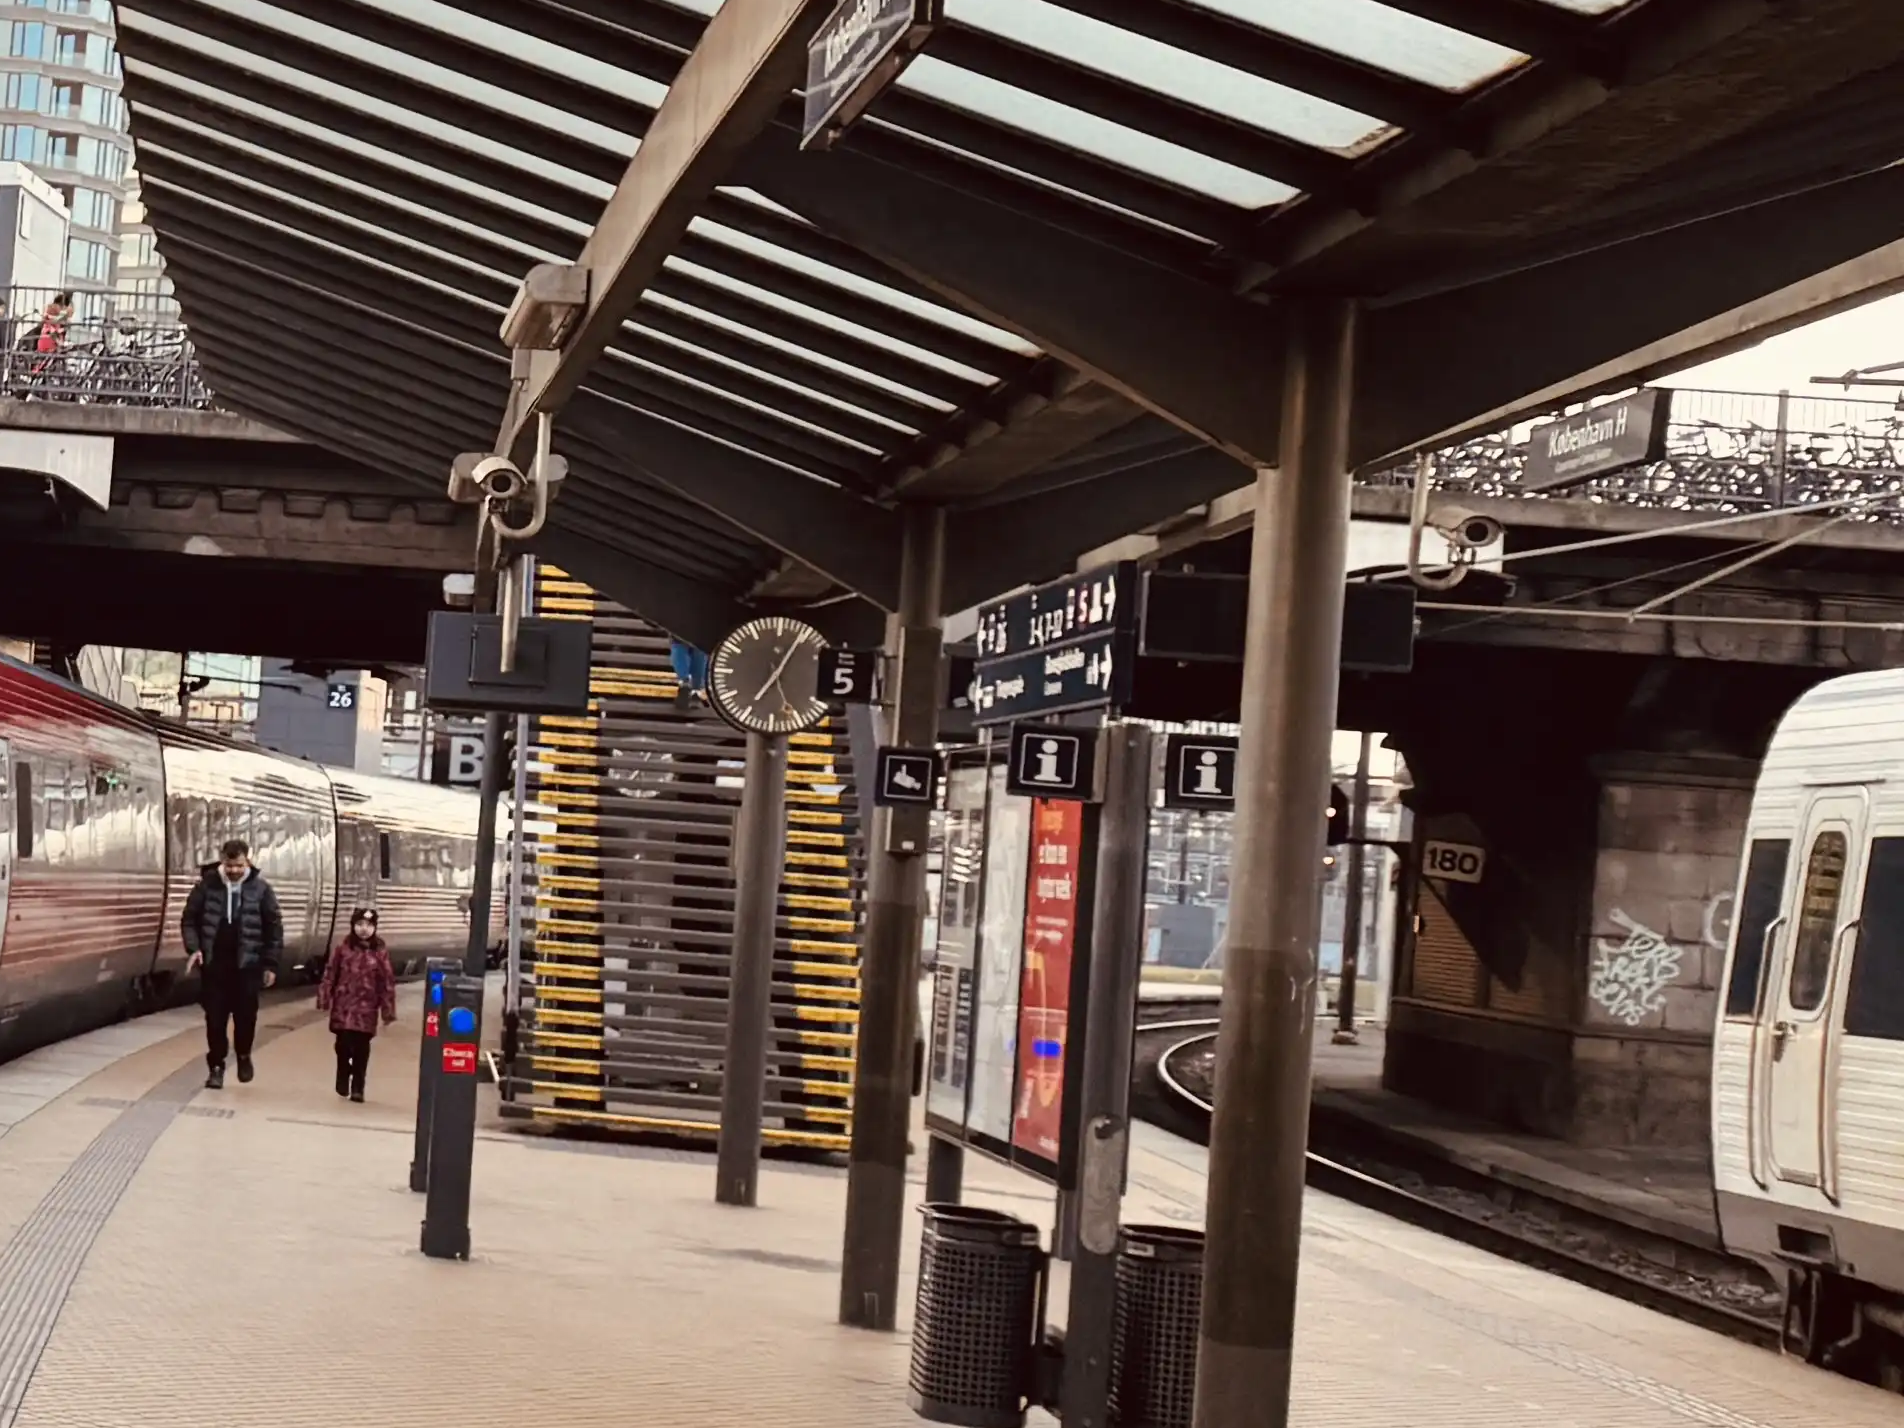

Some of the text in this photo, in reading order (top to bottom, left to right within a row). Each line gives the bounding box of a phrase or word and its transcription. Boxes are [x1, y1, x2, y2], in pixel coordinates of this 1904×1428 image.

[1615, 406, 1628, 437] H
[833, 667, 854, 695] 5
[329, 691, 352, 708] 26
[448, 736, 485, 782] B
[1428, 846, 1479, 875] 180
